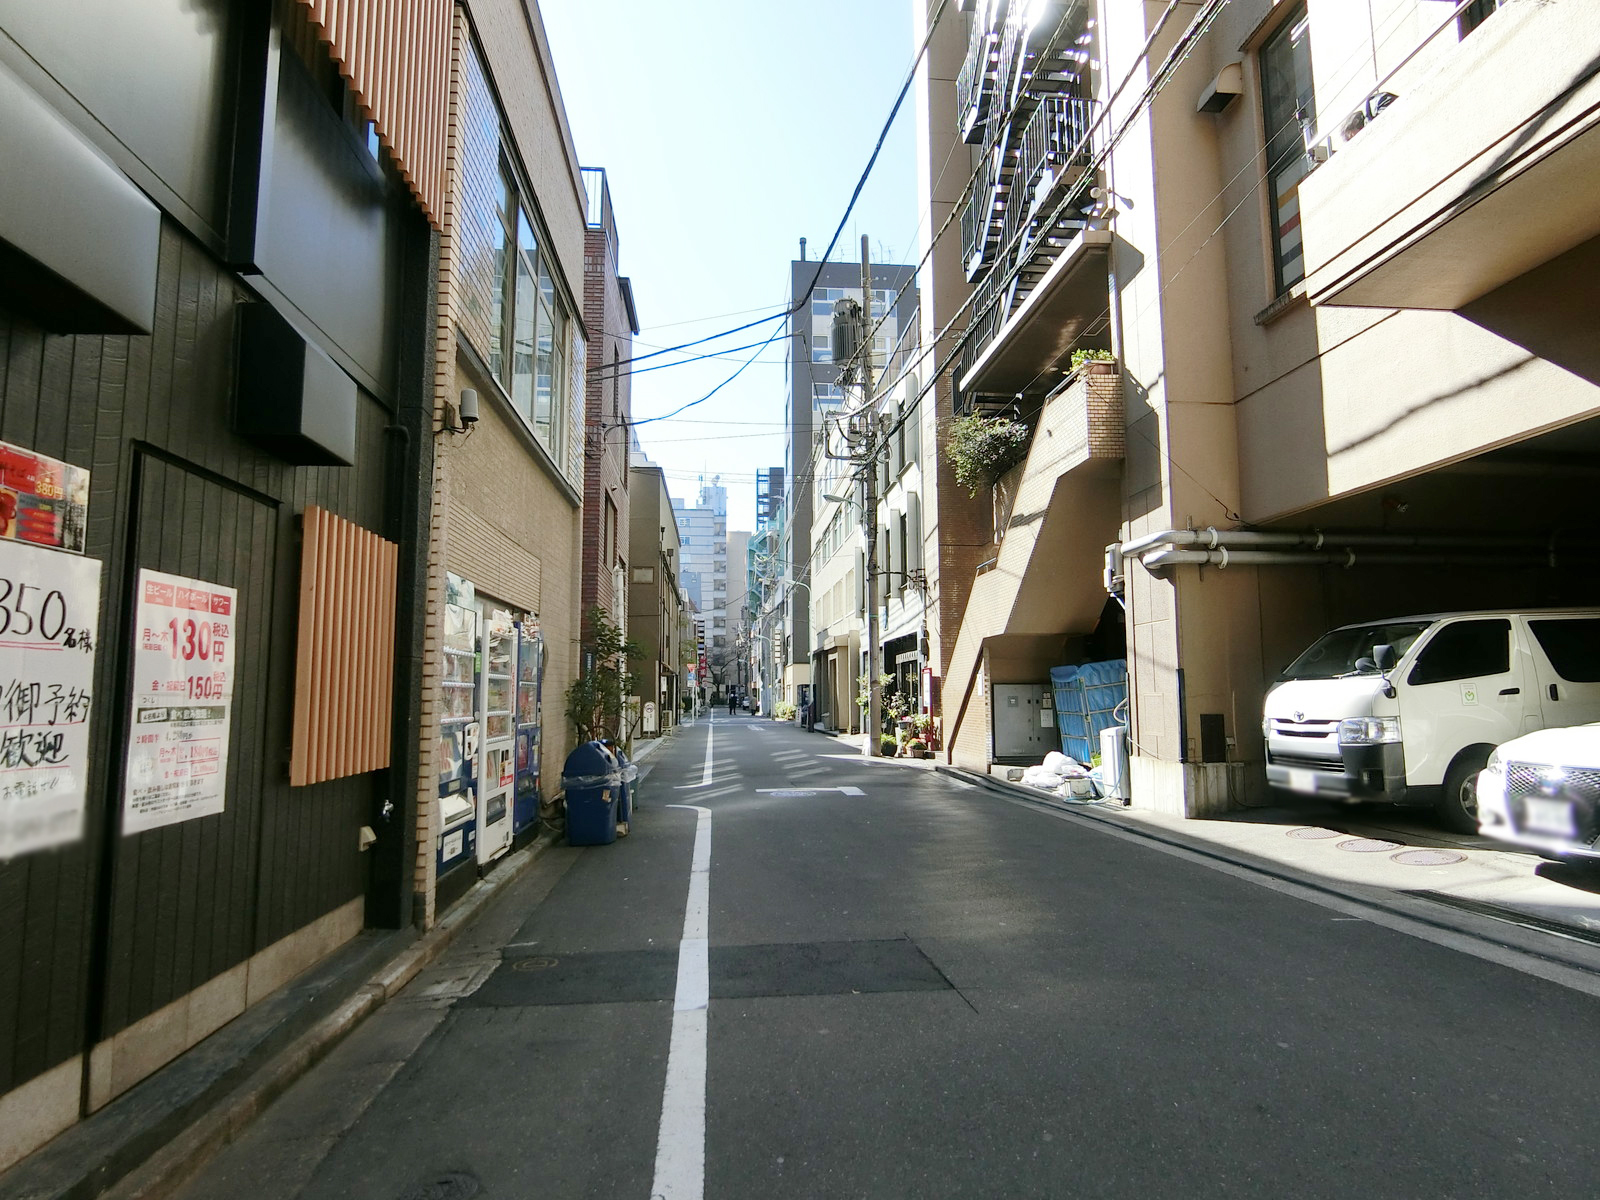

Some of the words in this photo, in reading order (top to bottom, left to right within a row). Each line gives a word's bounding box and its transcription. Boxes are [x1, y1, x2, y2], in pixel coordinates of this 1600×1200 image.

[146, 583, 173, 597] 生ビール
[177, 589, 208, 604] ハイボール
[213, 596, 230, 607] サワー
